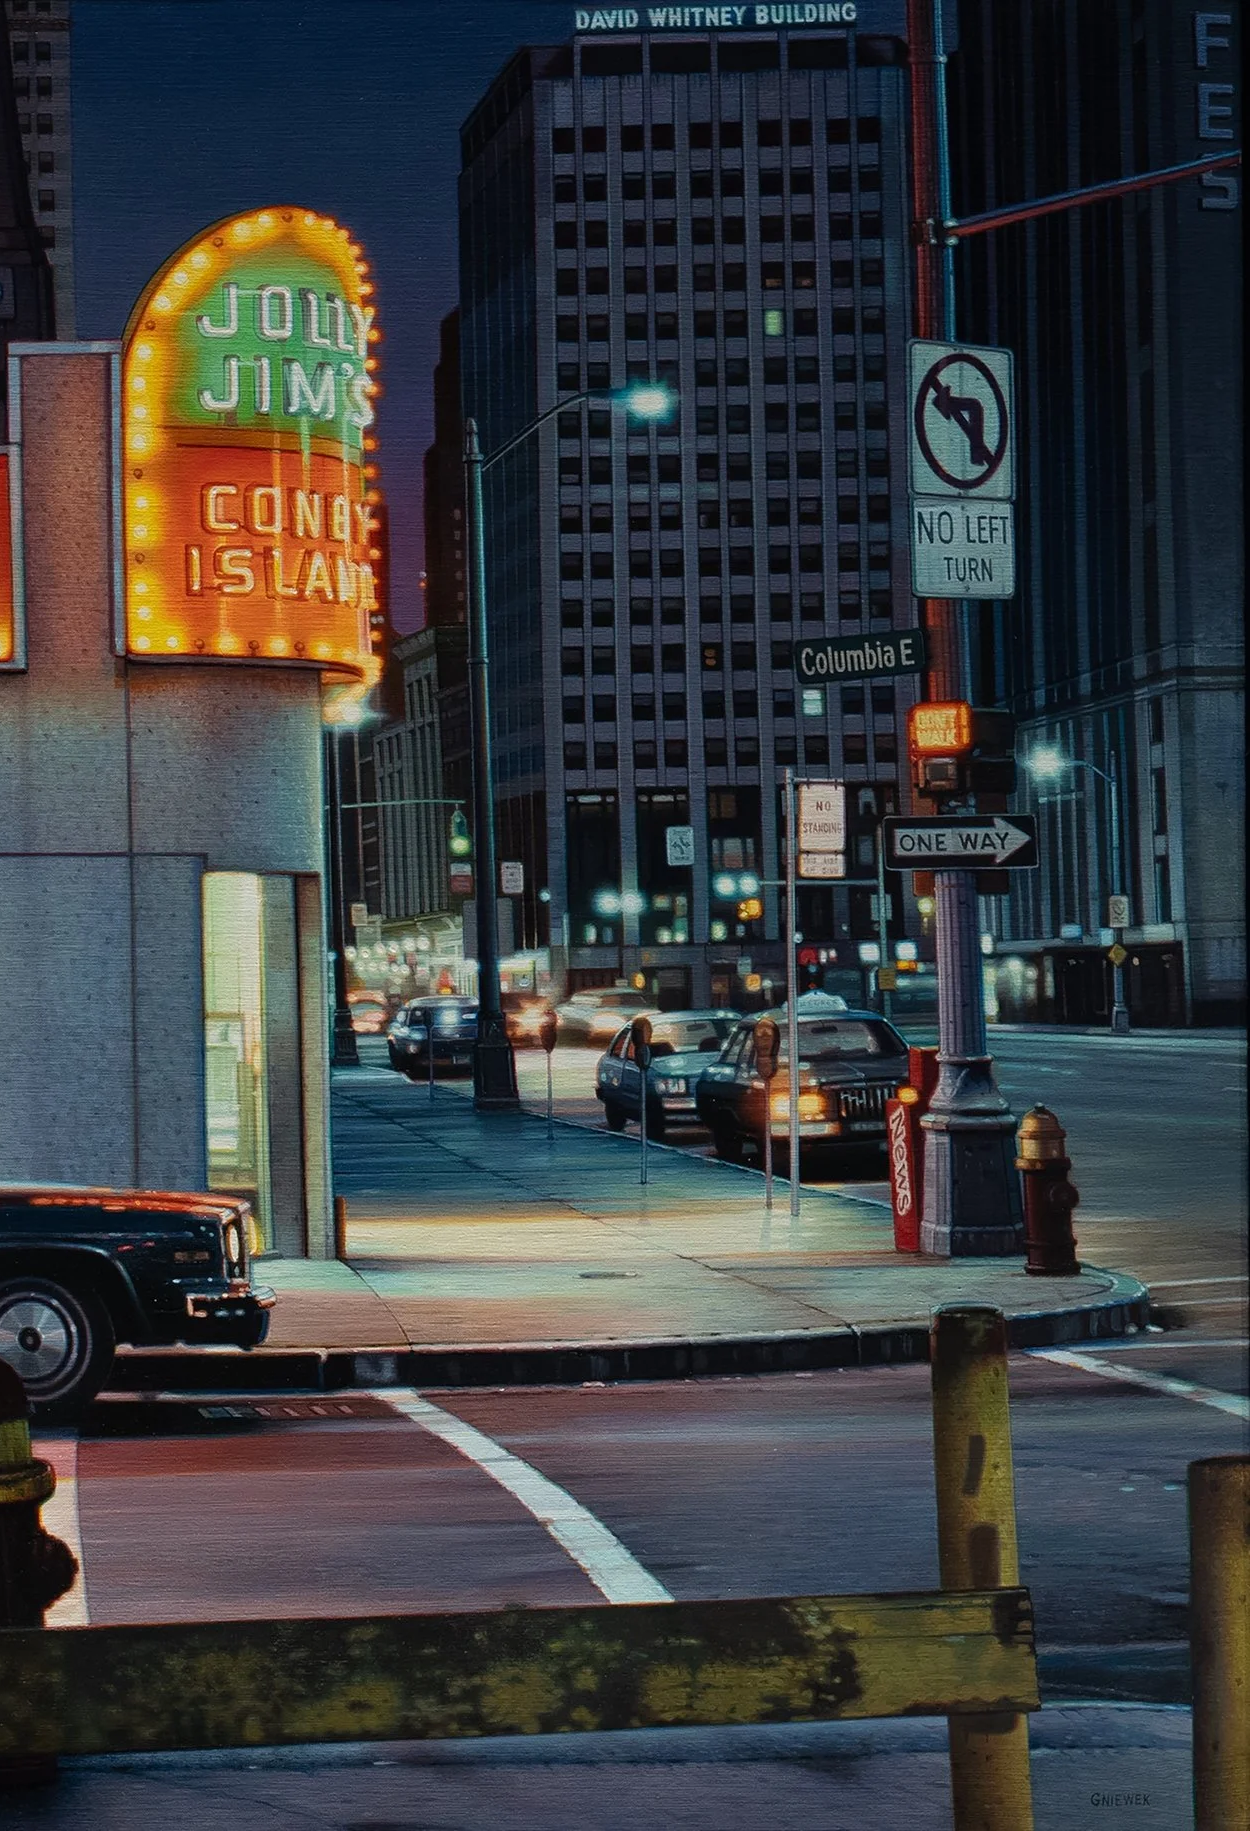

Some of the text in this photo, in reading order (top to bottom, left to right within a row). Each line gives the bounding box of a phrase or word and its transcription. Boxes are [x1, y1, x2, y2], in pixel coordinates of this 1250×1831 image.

[575, 3, 857, 30] DAVID WHITNEY BUILDING
[196, 283, 374, 358] JOLLY
[197, 355, 375, 430] JIM'S
[917, 510, 1009, 544] NO LEFT
[943, 556, 993, 582] TURN
[801, 638, 915, 676] Columbia E
[815, 801, 832, 812] NO
[802, 822, 843, 834] STANDING
[900, 831, 1010, 852] ONE WAY
[1090, 1792, 1151, 1807] GNIEWEK
